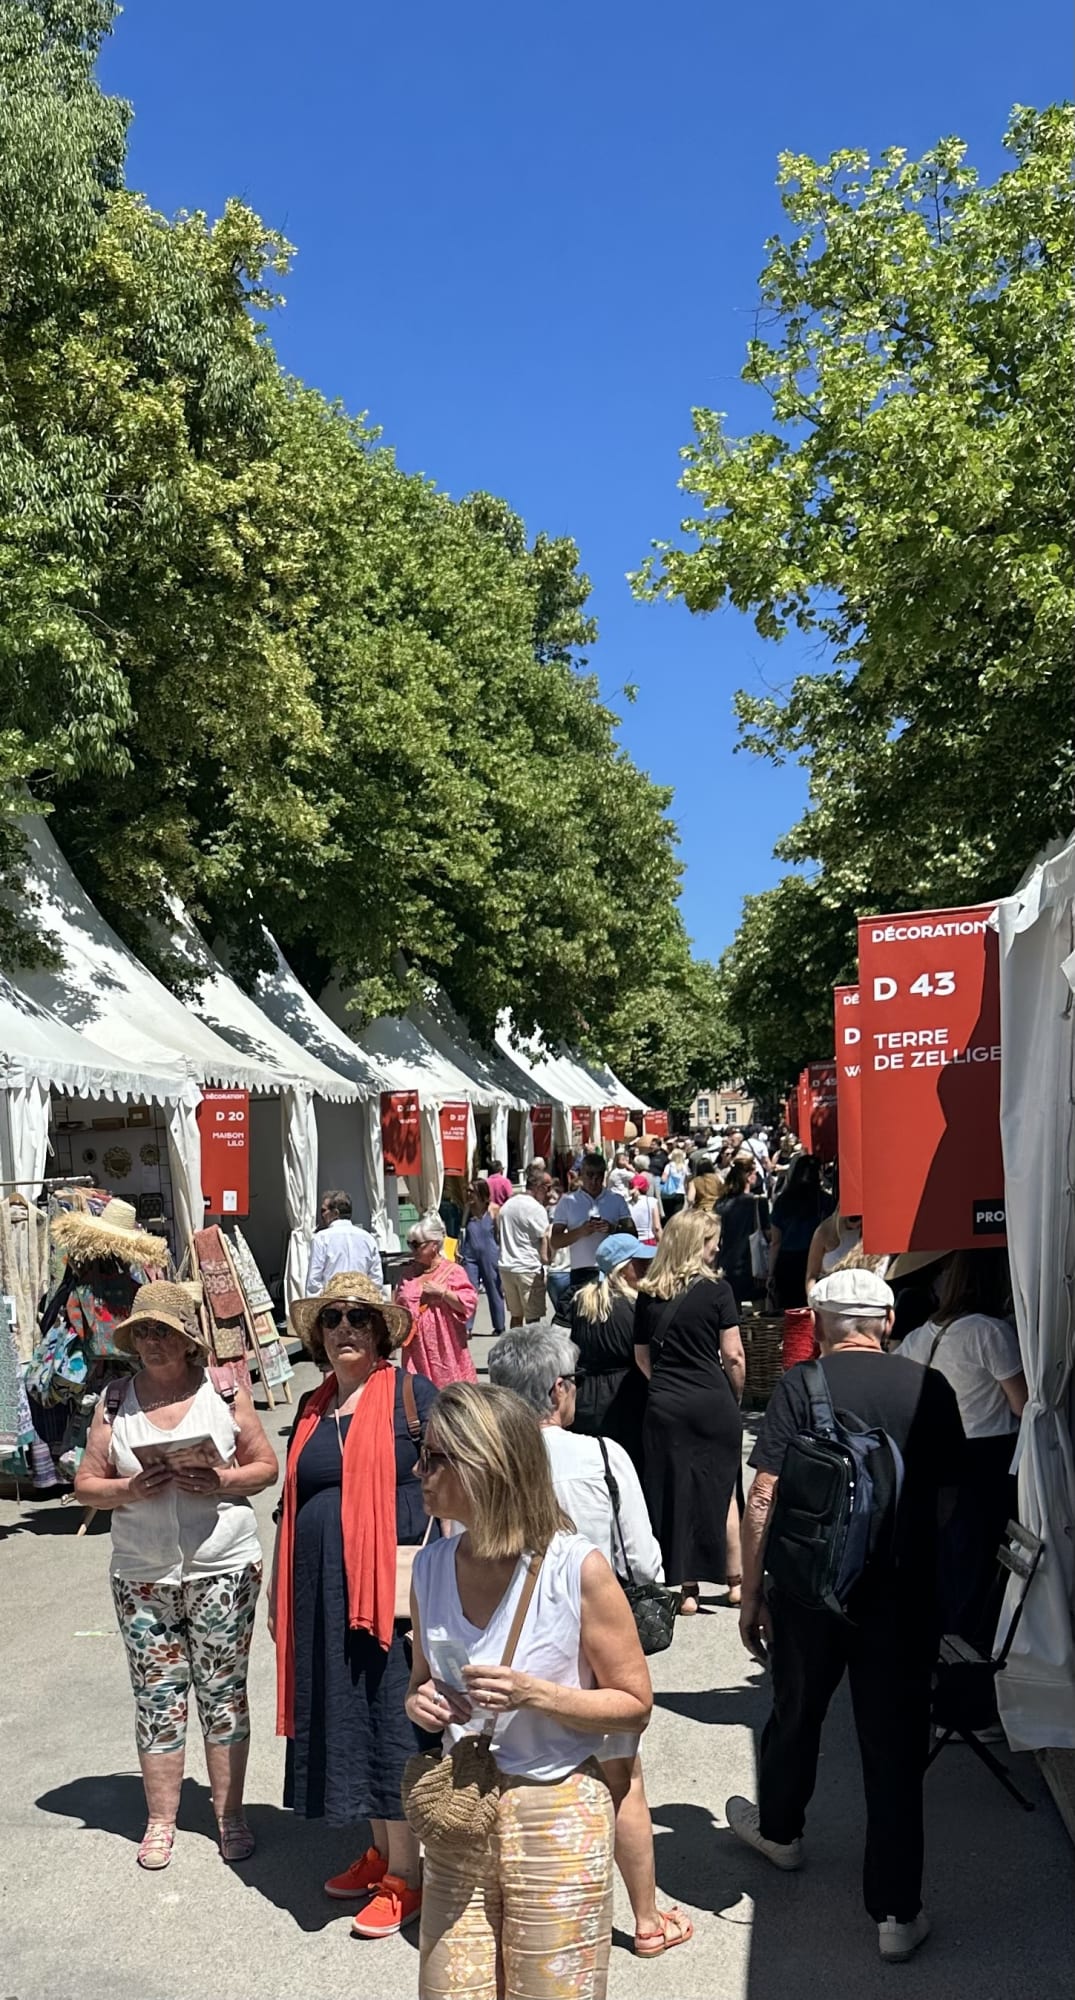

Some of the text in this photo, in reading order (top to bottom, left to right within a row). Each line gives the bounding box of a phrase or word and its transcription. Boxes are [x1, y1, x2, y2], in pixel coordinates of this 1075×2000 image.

[872, 921, 987, 943] DÉCORATION
[873, 971, 956, 1001] D 43
[844, 1027, 861, 1045] D
[873, 1028, 949, 1049] TERRE
[874, 1053, 904, 1071] DE
[215, 1111, 245, 1121] D 20
